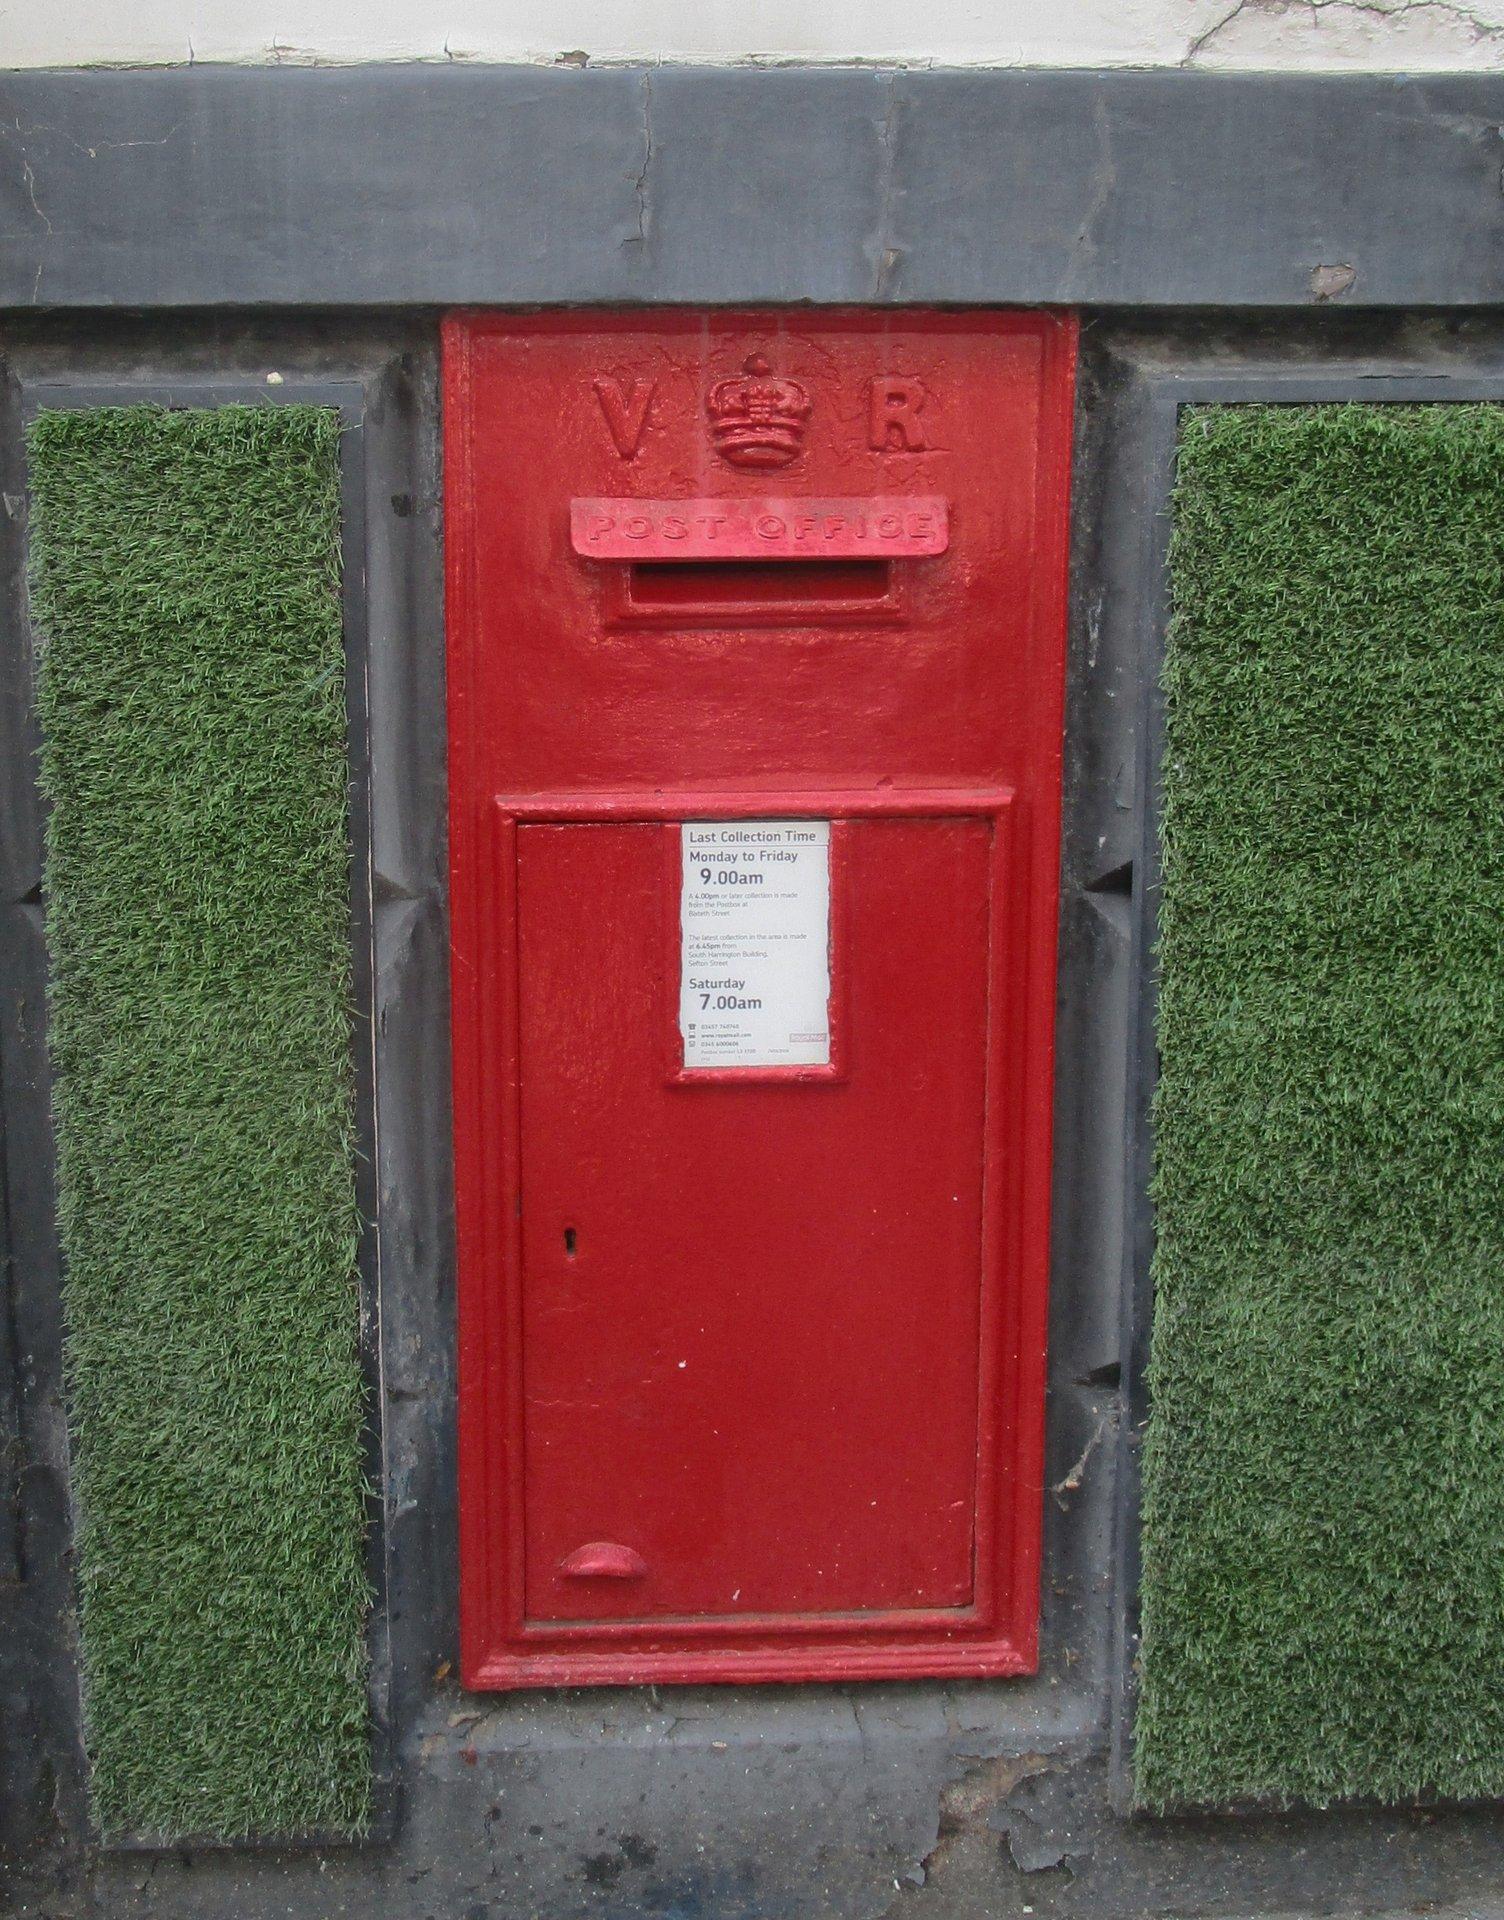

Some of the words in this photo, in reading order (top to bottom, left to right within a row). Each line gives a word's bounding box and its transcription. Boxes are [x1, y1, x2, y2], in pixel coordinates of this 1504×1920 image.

[592, 377, 657, 462] V
[868, 375, 928, 452] R
[589, 515, 727, 541] POST
[756, 513, 936, 540] OFFICE
[690, 832, 716, 842] Last
[720, 831, 781, 842] Collection
[785, 830, 816, 842] Time
[690, 851, 738, 864] Monday
[743, 852, 755, 861] to
[760, 851, 798, 863] Friday
[700, 868, 763, 885] 9.00am
[695, 893, 719, 901] 4.00pm
[689, 978, 746, 991] Saturday
[699, 994, 762, 1010] 7.00am
